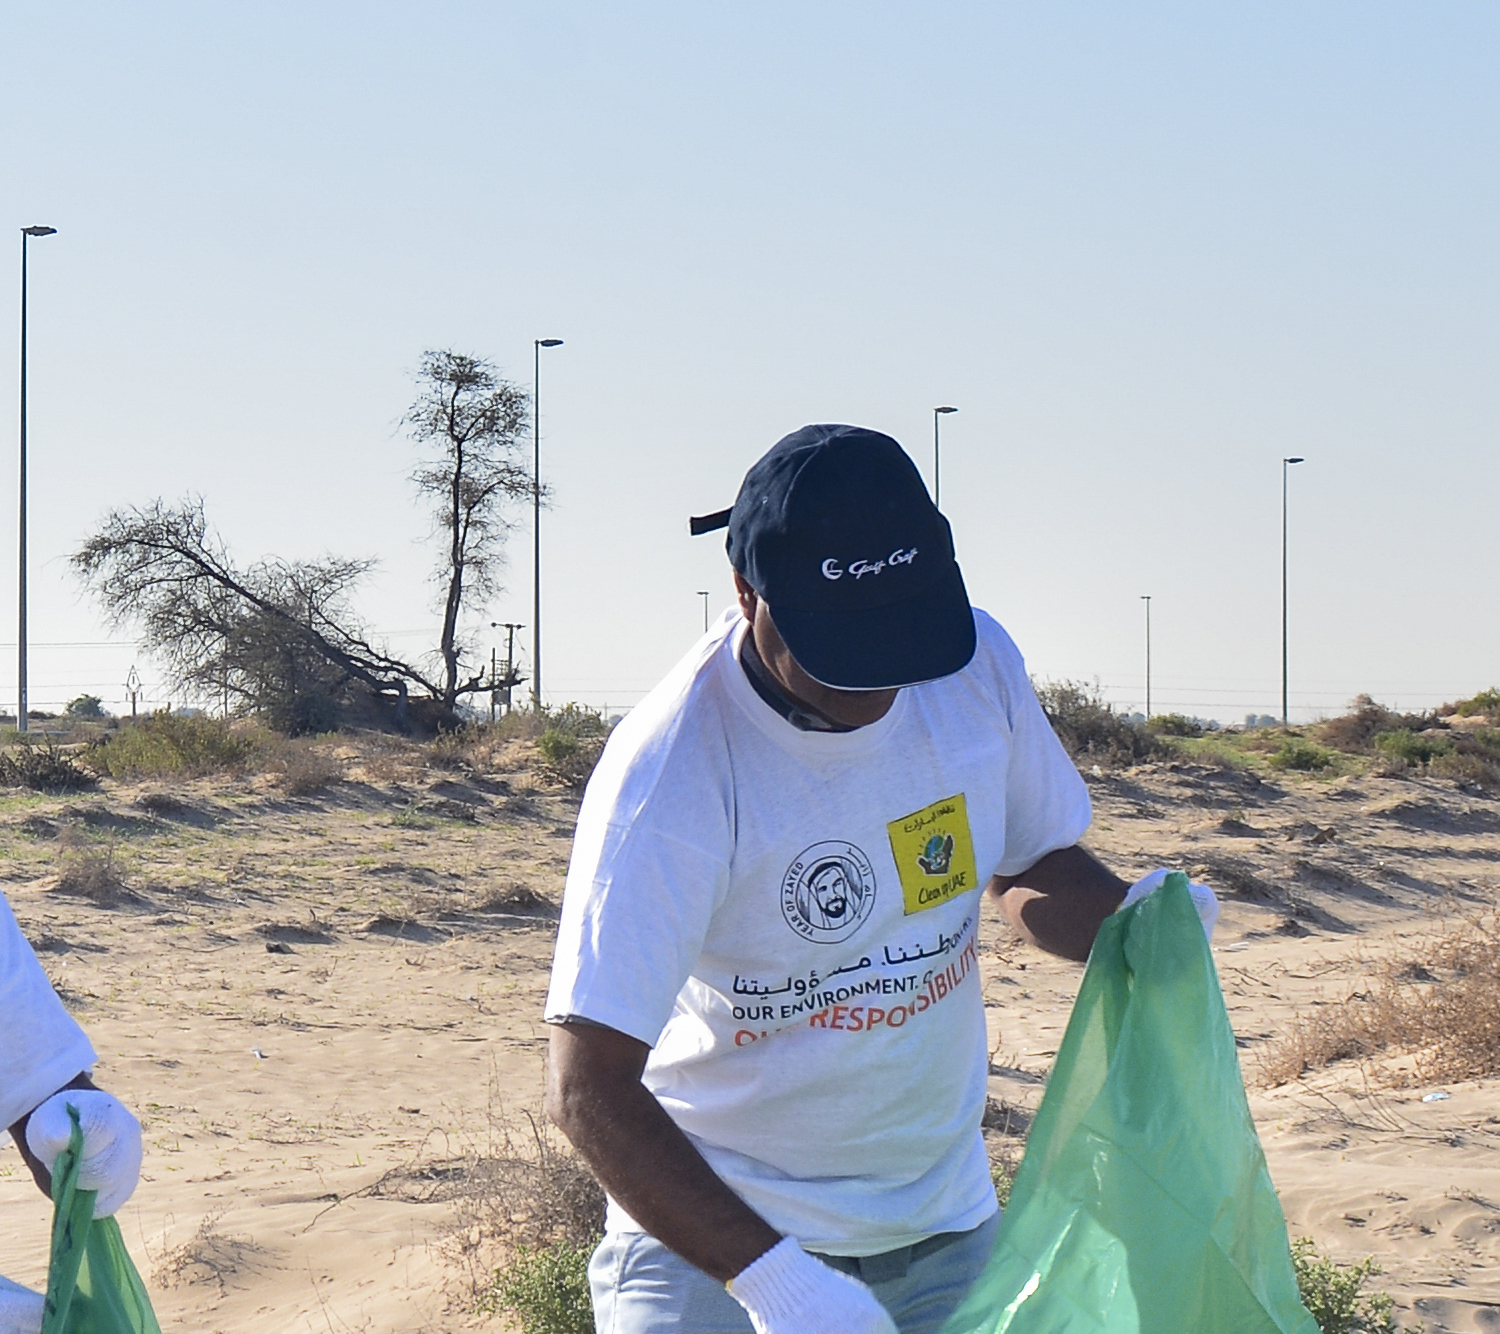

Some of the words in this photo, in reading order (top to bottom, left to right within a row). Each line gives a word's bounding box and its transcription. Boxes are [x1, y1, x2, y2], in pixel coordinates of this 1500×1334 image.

[784, 861, 804, 894] ZAYED
[786, 900, 795, 912] OF
[790, 915, 814, 937] YEAR
[732, 1005, 775, 1021] OUR
